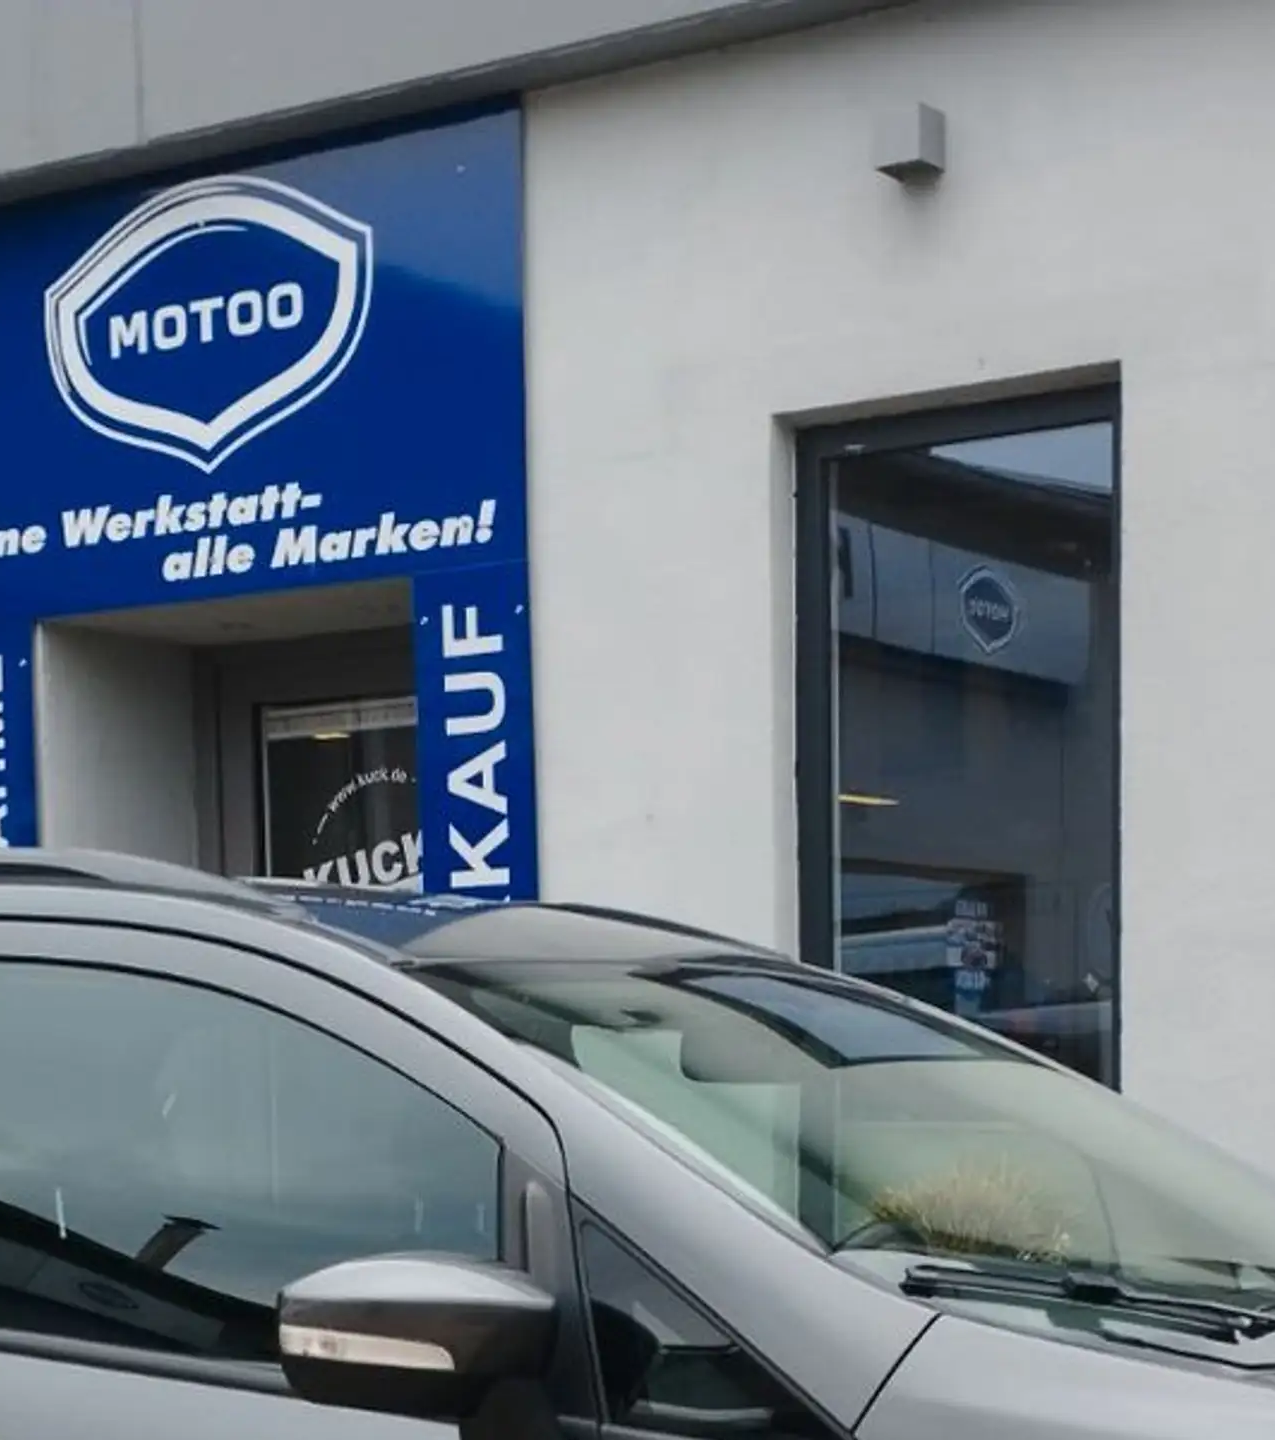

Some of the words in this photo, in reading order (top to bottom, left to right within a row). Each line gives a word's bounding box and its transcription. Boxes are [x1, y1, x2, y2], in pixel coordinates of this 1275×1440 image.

[110, 282, 304, 359] MOTOO
[61, 482, 322, 547] Werkstatt-
[162, 536, 255, 582] alle
[270, 499, 496, 569] Marken!
[441, 604, 511, 901] KAUF
